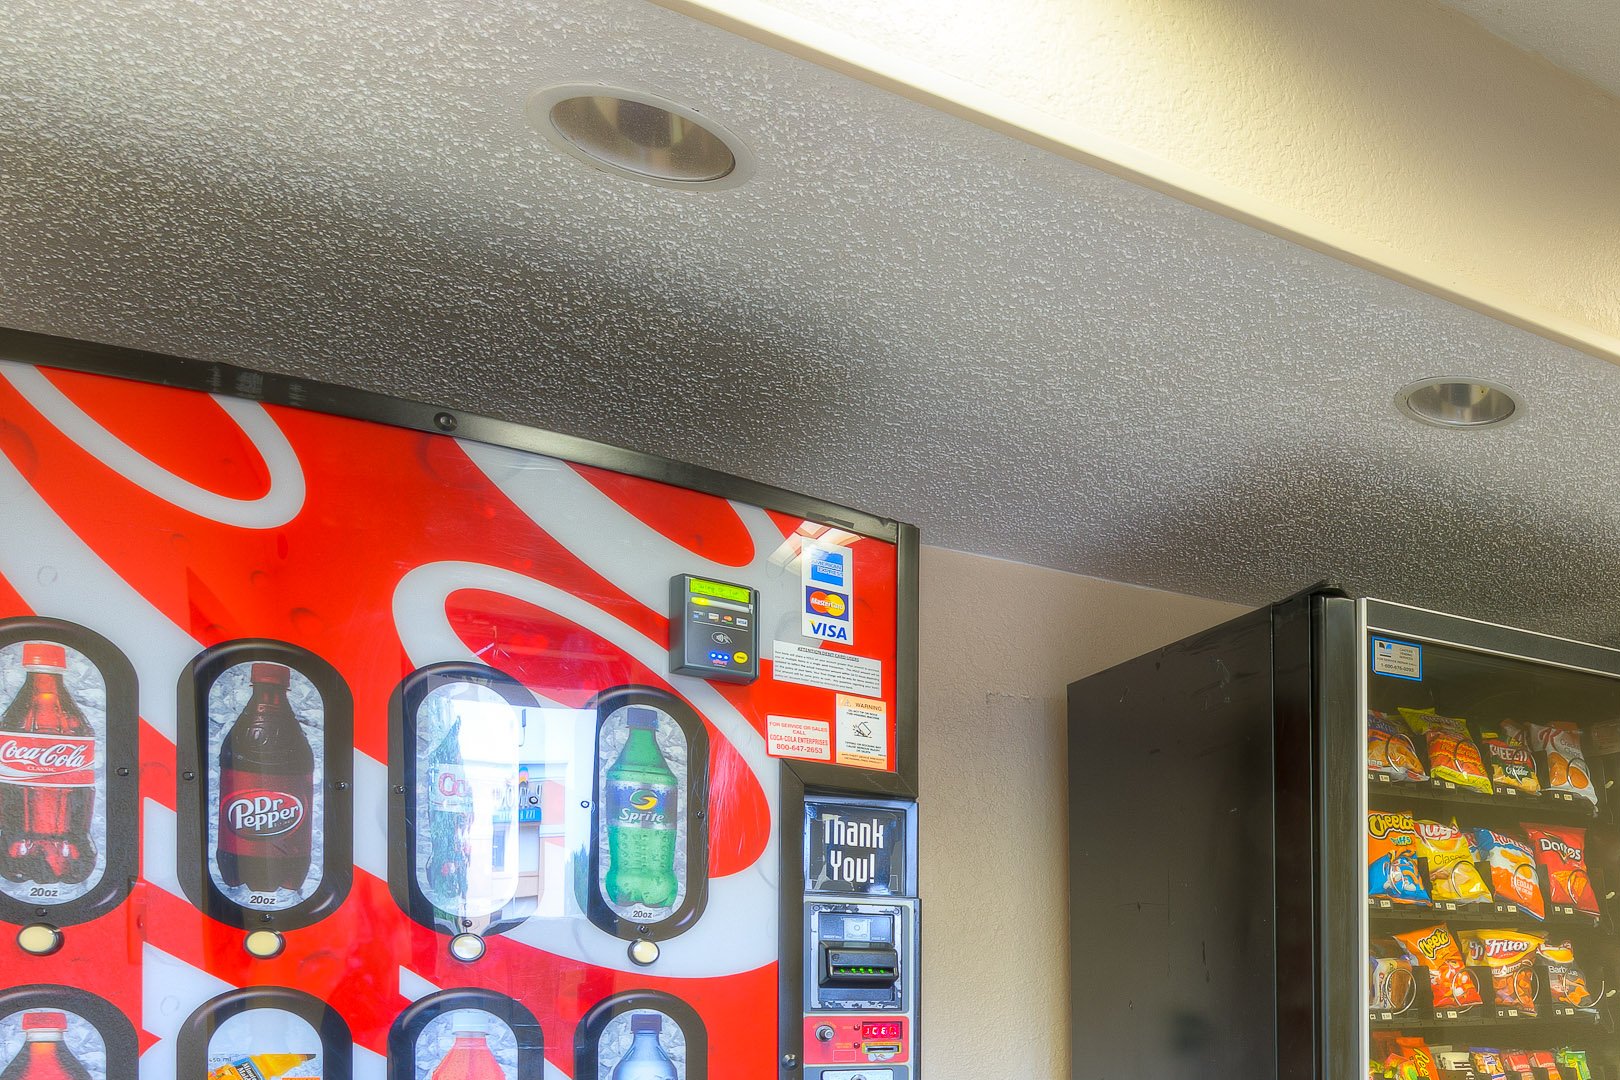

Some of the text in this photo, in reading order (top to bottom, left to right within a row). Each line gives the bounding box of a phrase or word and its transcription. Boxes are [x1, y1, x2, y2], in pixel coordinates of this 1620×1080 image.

[811, 597, 843, 610] MasterCard
[810, 620, 847, 640] VISA
[855, 701, 883, 712] WARNING
[769, 734, 797, 743] COCA-COLA
[0, 739, 88, 768] Coca-Cola
[255, 797, 283, 815] Dr
[233, 800, 299, 831] Pepper
[619, 807, 665, 824] Sprite
[822, 813, 884, 849] Thank
[1539, 838, 1582, 862] Doritos
[830, 850, 876, 884] You!
[30, 887, 59, 898] 20oz
[250, 895, 276, 906] 20oz
[632, 908, 654, 919] 20oz
[1484, 938, 1529, 957] Fritos
